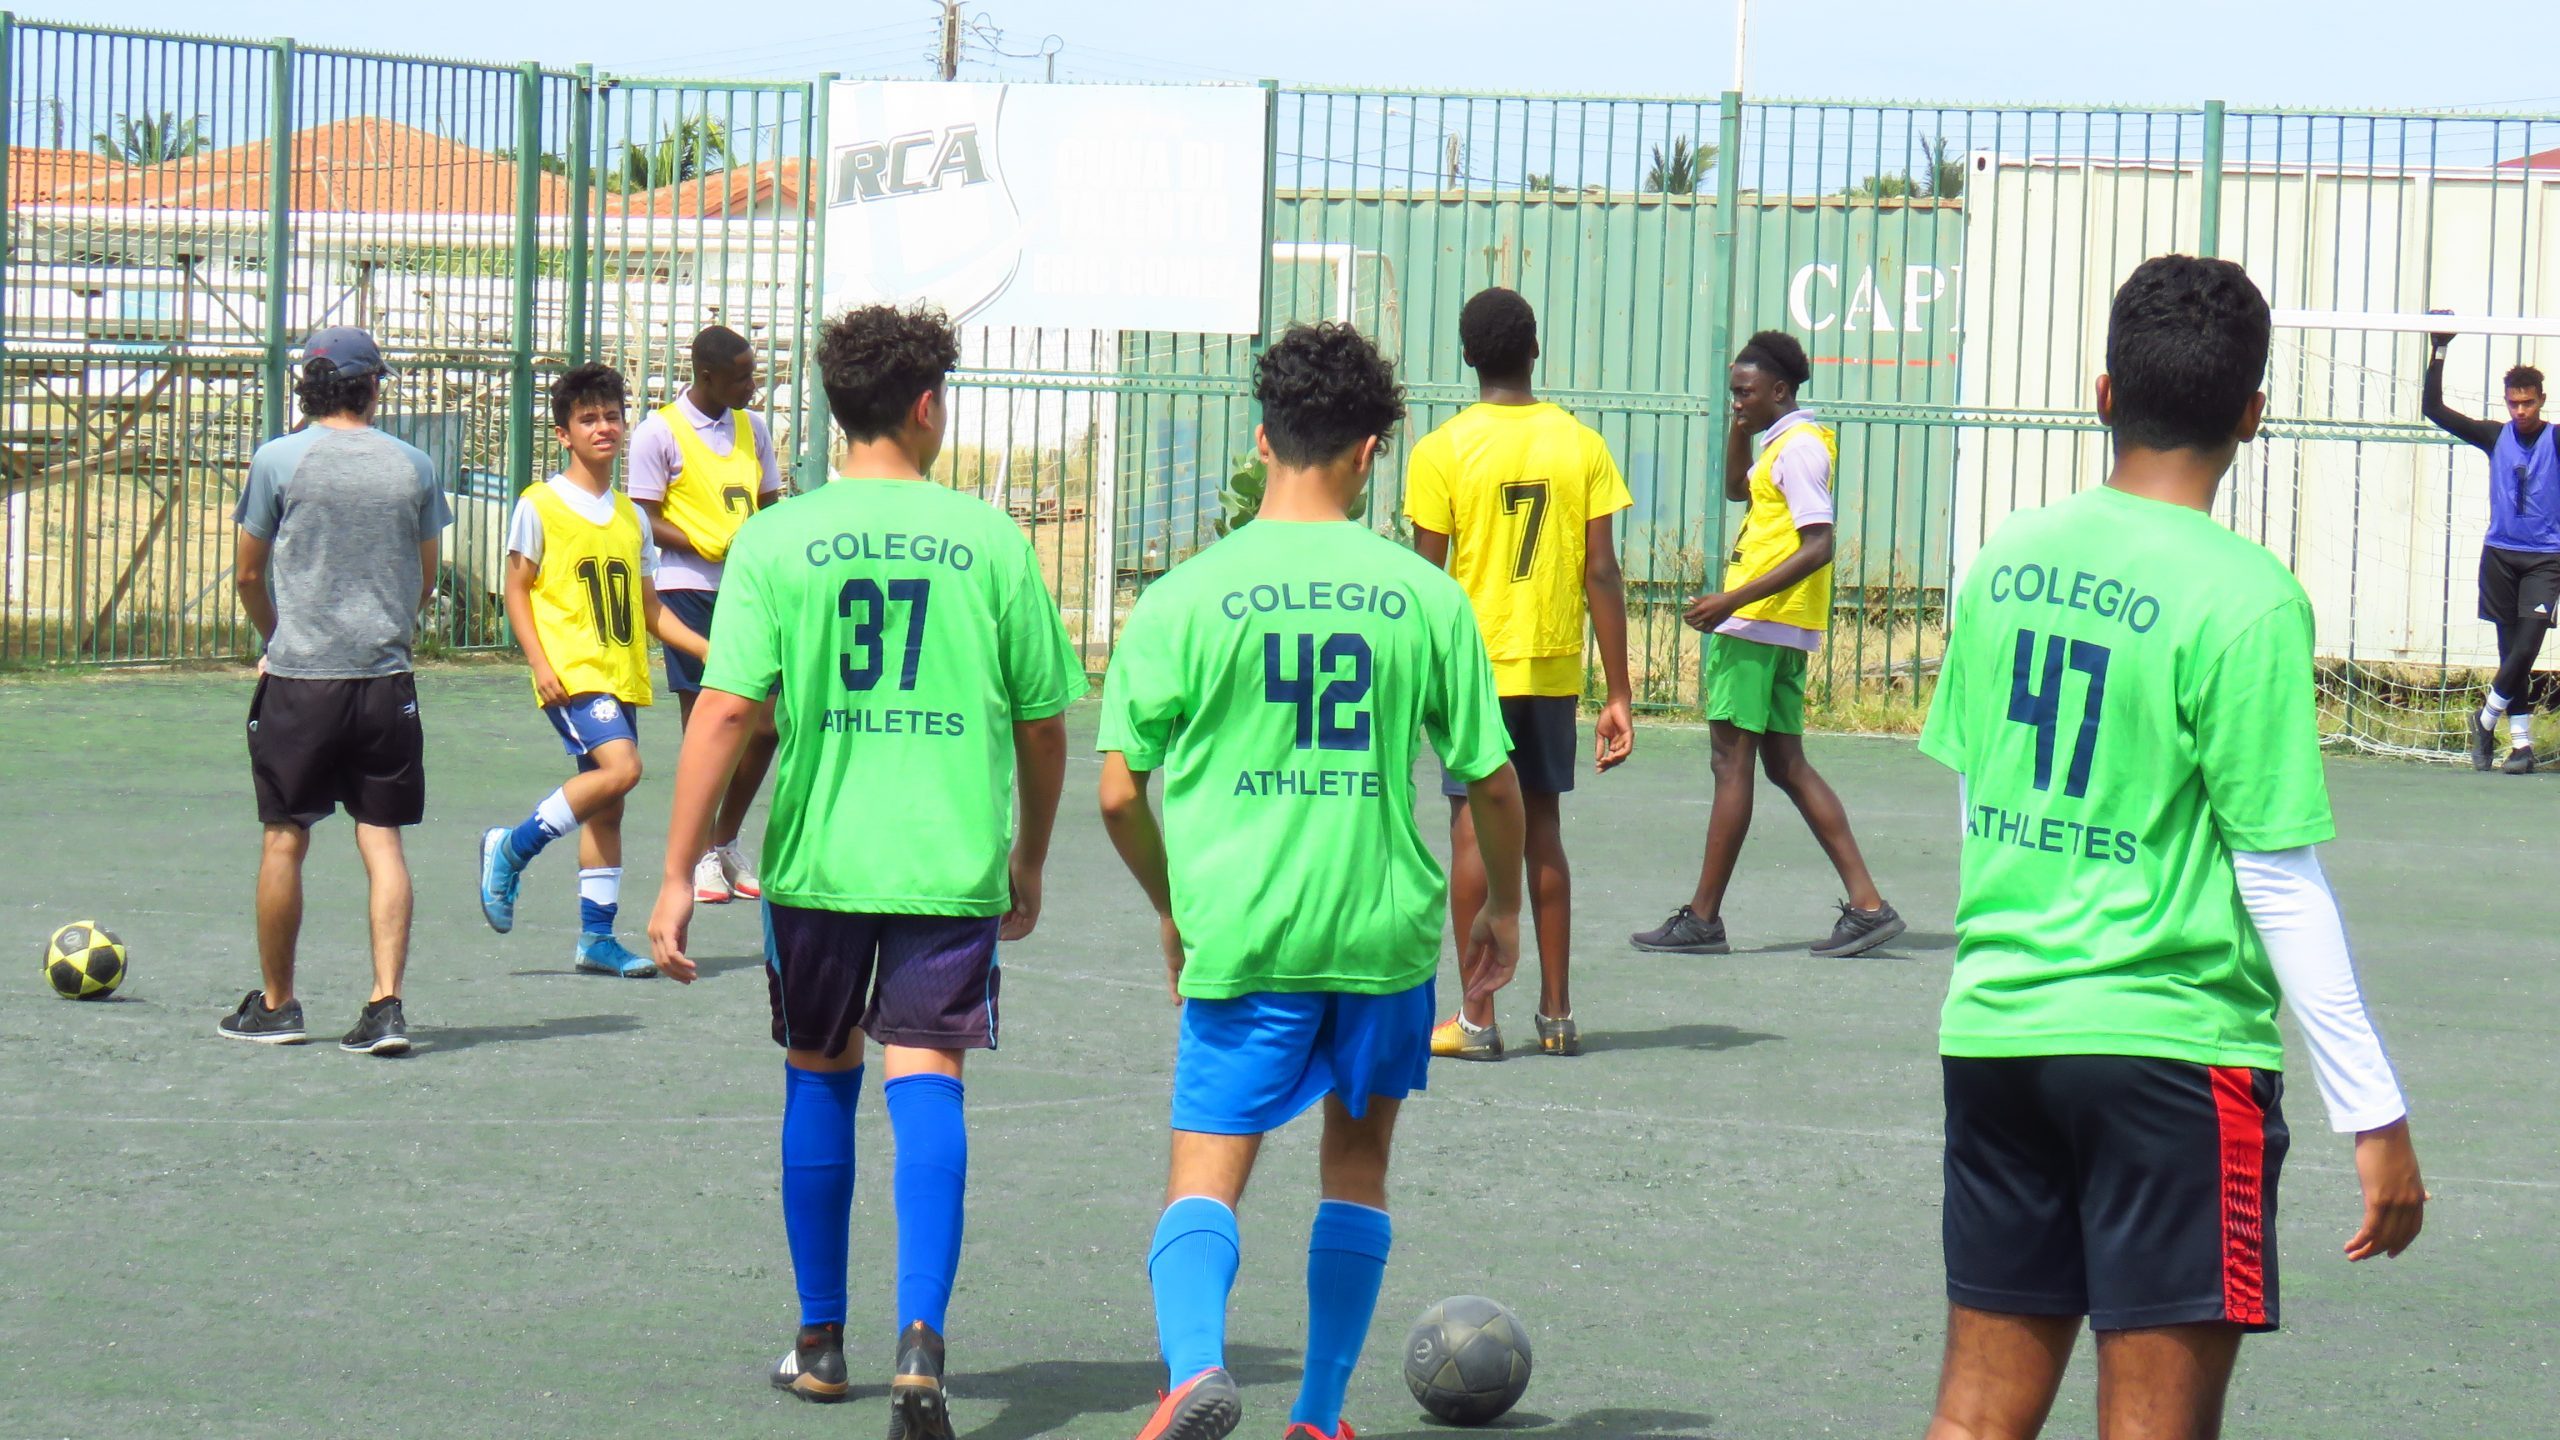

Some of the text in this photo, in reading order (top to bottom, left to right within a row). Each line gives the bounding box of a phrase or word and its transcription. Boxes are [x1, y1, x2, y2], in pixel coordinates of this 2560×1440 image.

[828, 123, 994, 209] RCA
[1055, 191, 1229, 242] TALENTO
[806, 532, 974, 572] COLEGIO
[1500, 478, 1551, 584] 7
[575, 555, 634, 648] 10
[1221, 582, 1407, 620] COLEGIO
[1990, 563, 2161, 634] COLEGIO
[838, 578, 931, 692] 37
[819, 709, 966, 737] ATHLETES
[1264, 632, 1372, 752] 42
[2006, 628, 2112, 799] 47
[1233, 770, 1381, 798] ATHLETE
[1966, 803, 2138, 865] ATHLETES
